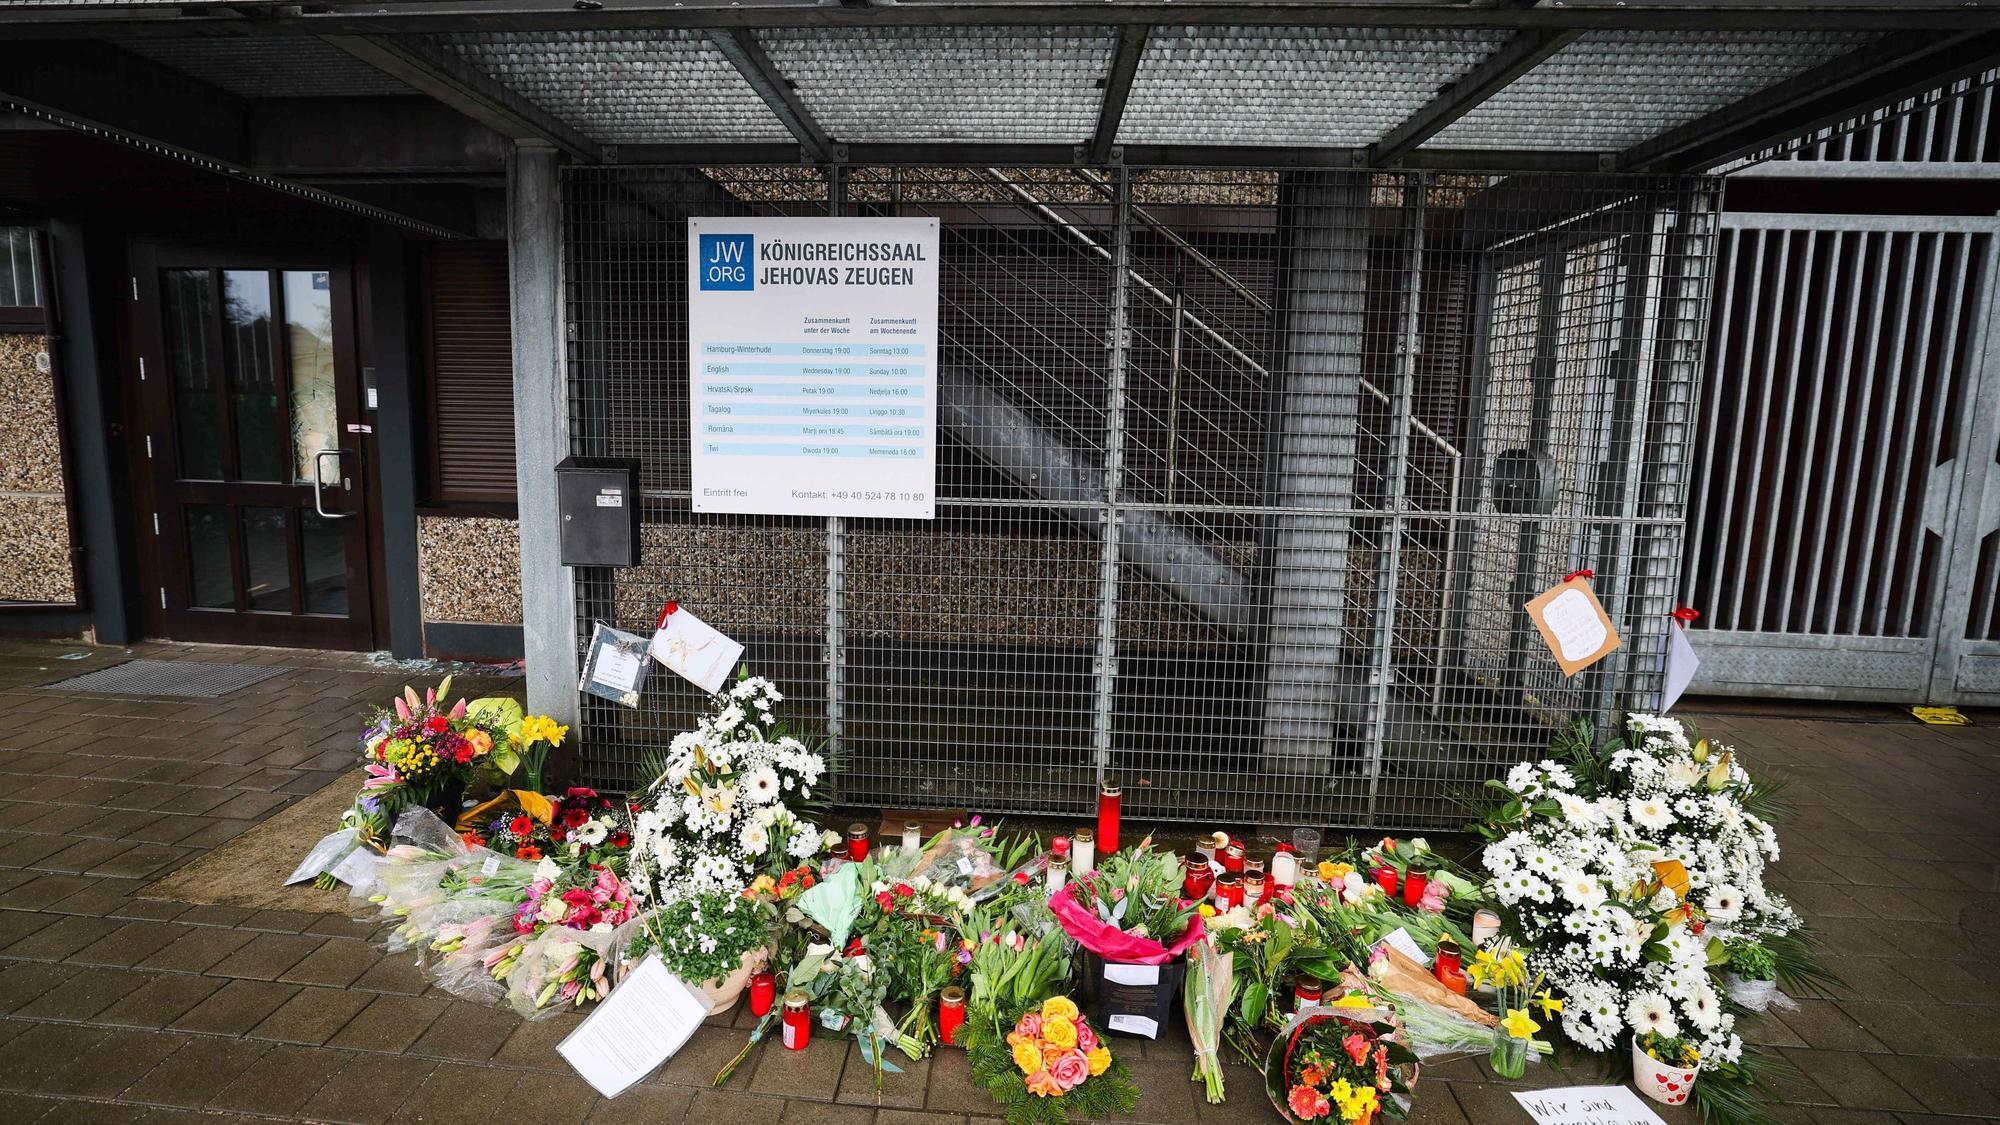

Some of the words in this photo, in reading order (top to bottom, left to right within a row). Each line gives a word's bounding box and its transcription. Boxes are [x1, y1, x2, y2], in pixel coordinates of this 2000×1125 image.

[710, 241, 744, 263] JW
[761, 240, 926, 261] KÖNIGREICHSSAAL
[706, 267, 745, 282] .ORG
[760, 267, 839, 285] JEHOVAS
[845, 268, 913, 286] ZEUGEN
[880, 327, 916, 335] Wochenende
[707, 345, 772, 355] Hamburg-Winterhude
[802, 347, 833, 355] Donnerstag
[707, 365, 729, 374] English
[802, 367, 833, 375] Wednesday
[869, 368, 889, 376] Sunday
[869, 387, 892, 396] Nedjelja
[708, 405, 731, 414] Tagalog
[802, 407, 832, 416] Miyerkules
[869, 408, 888, 416] Linggo
[708, 444, 719, 452] Twi
[703, 488, 731, 497] Eintritt
[733, 488, 748, 497] frei
[791, 490, 828, 499] Kontakt:
[831, 492, 848, 500] +49
[850, 491, 862, 500] 40
[864, 492, 882, 501] 524
[884, 492, 896, 501] 78
[900, 492, 910, 501] 10
[912, 492, 925, 502] 80
[1525, 1100, 1568, 1117] Wir
